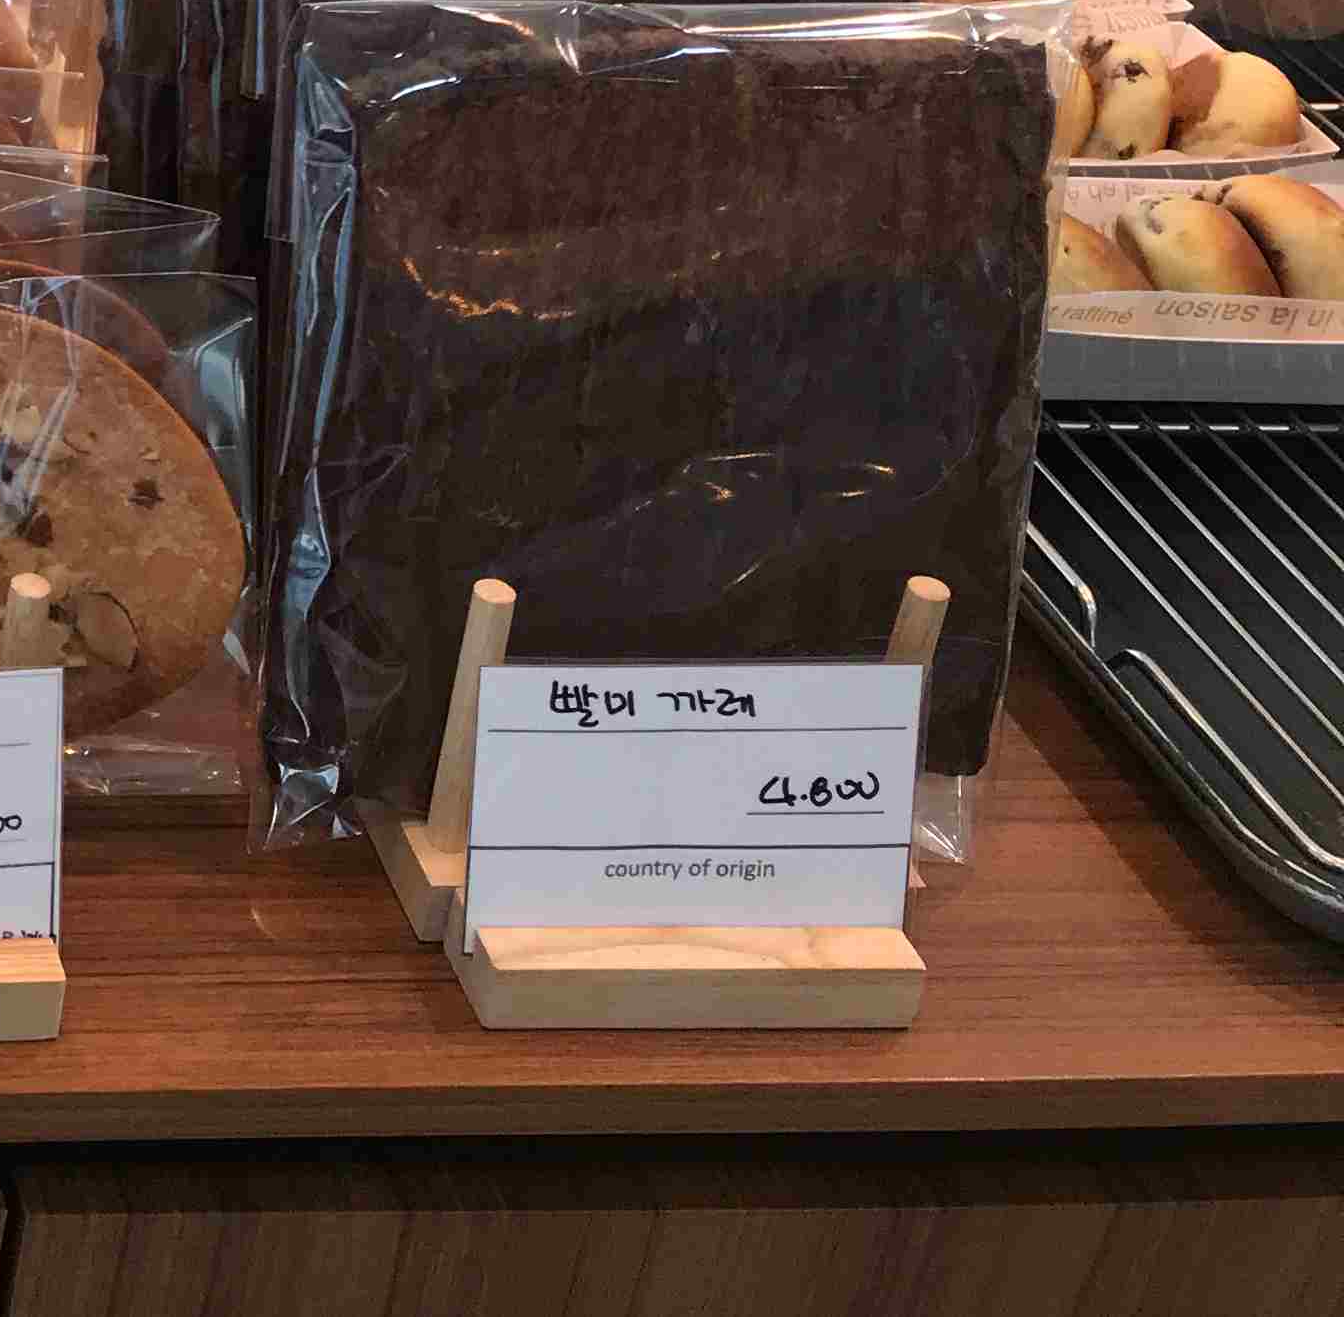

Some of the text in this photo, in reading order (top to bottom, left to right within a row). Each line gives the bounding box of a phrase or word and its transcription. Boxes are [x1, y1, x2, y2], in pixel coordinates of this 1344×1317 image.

[1154, 297, 1261, 325] saison
[549, 679, 636, 728] 빨미
[758, 771, 880, 808] 4.800
[604, 857, 776, 881] country of origin
